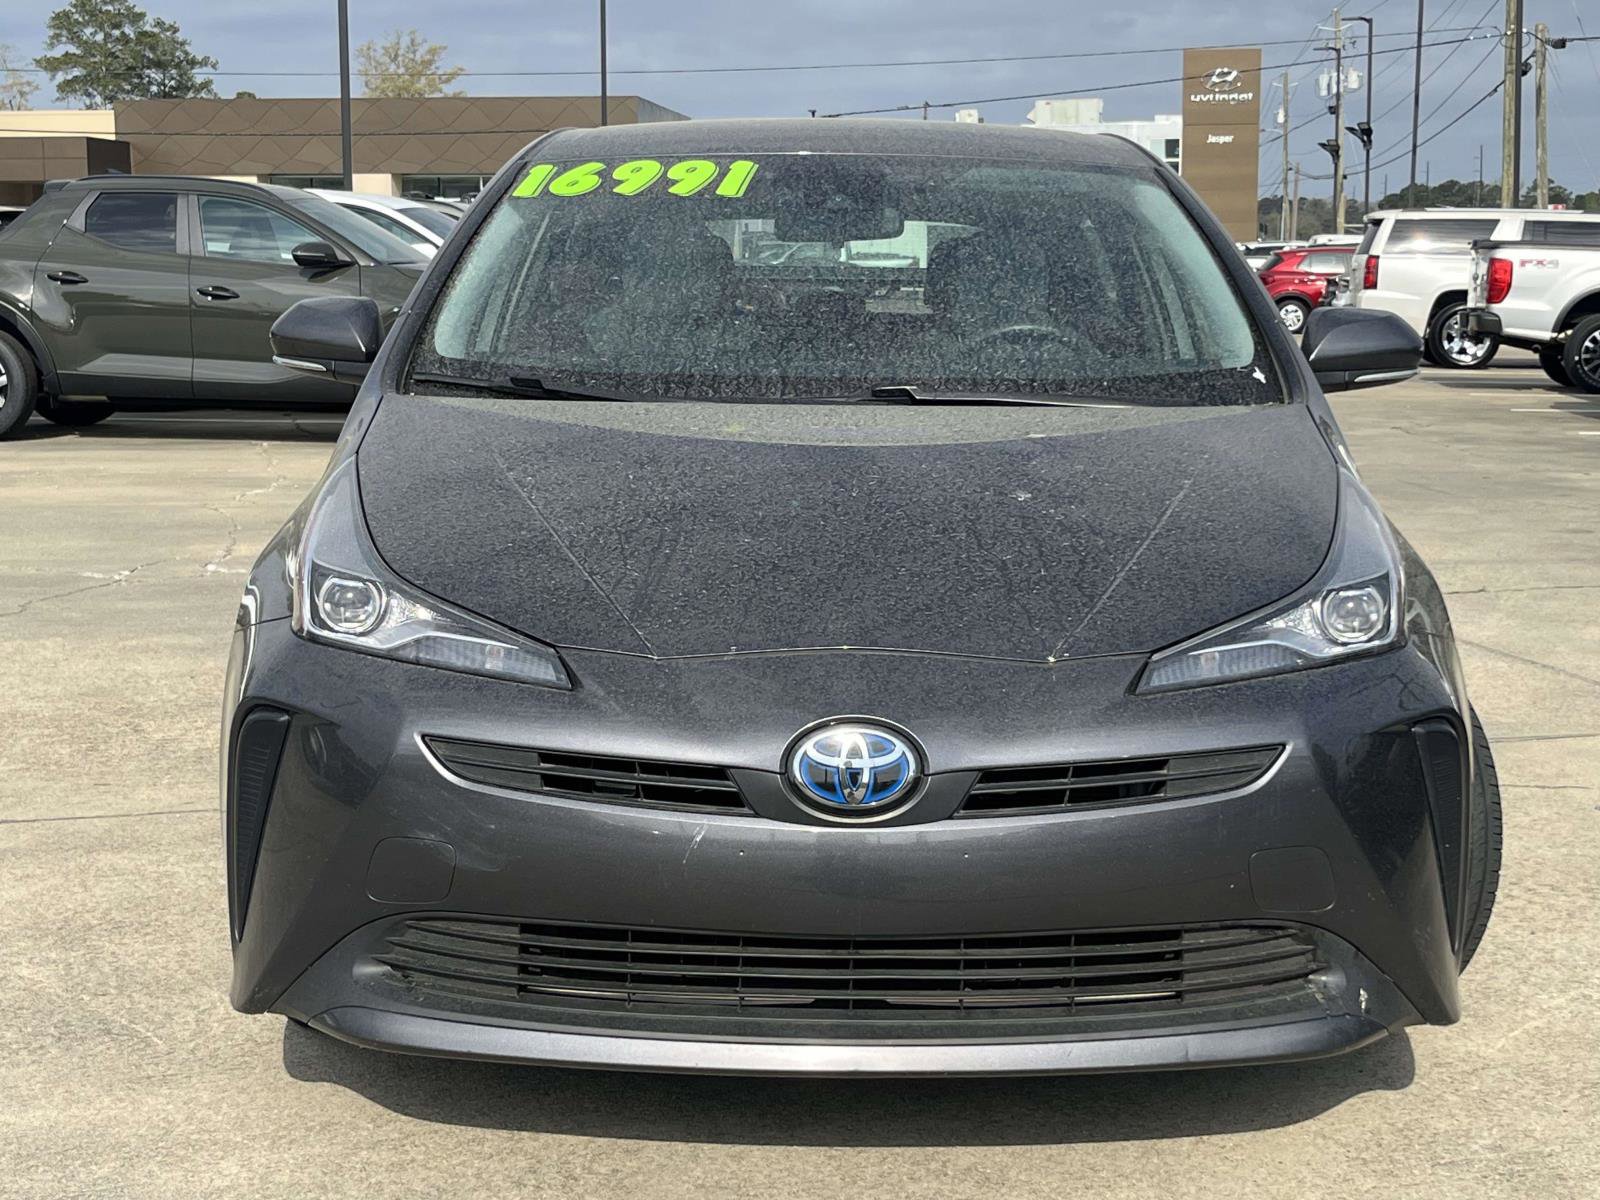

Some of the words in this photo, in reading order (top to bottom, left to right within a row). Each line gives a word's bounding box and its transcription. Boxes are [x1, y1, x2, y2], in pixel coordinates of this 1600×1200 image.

[1206, 134, 1235, 144] Jasper
[511, 159, 760, 198] 16991
[1519, 259, 1559, 269] FX4
